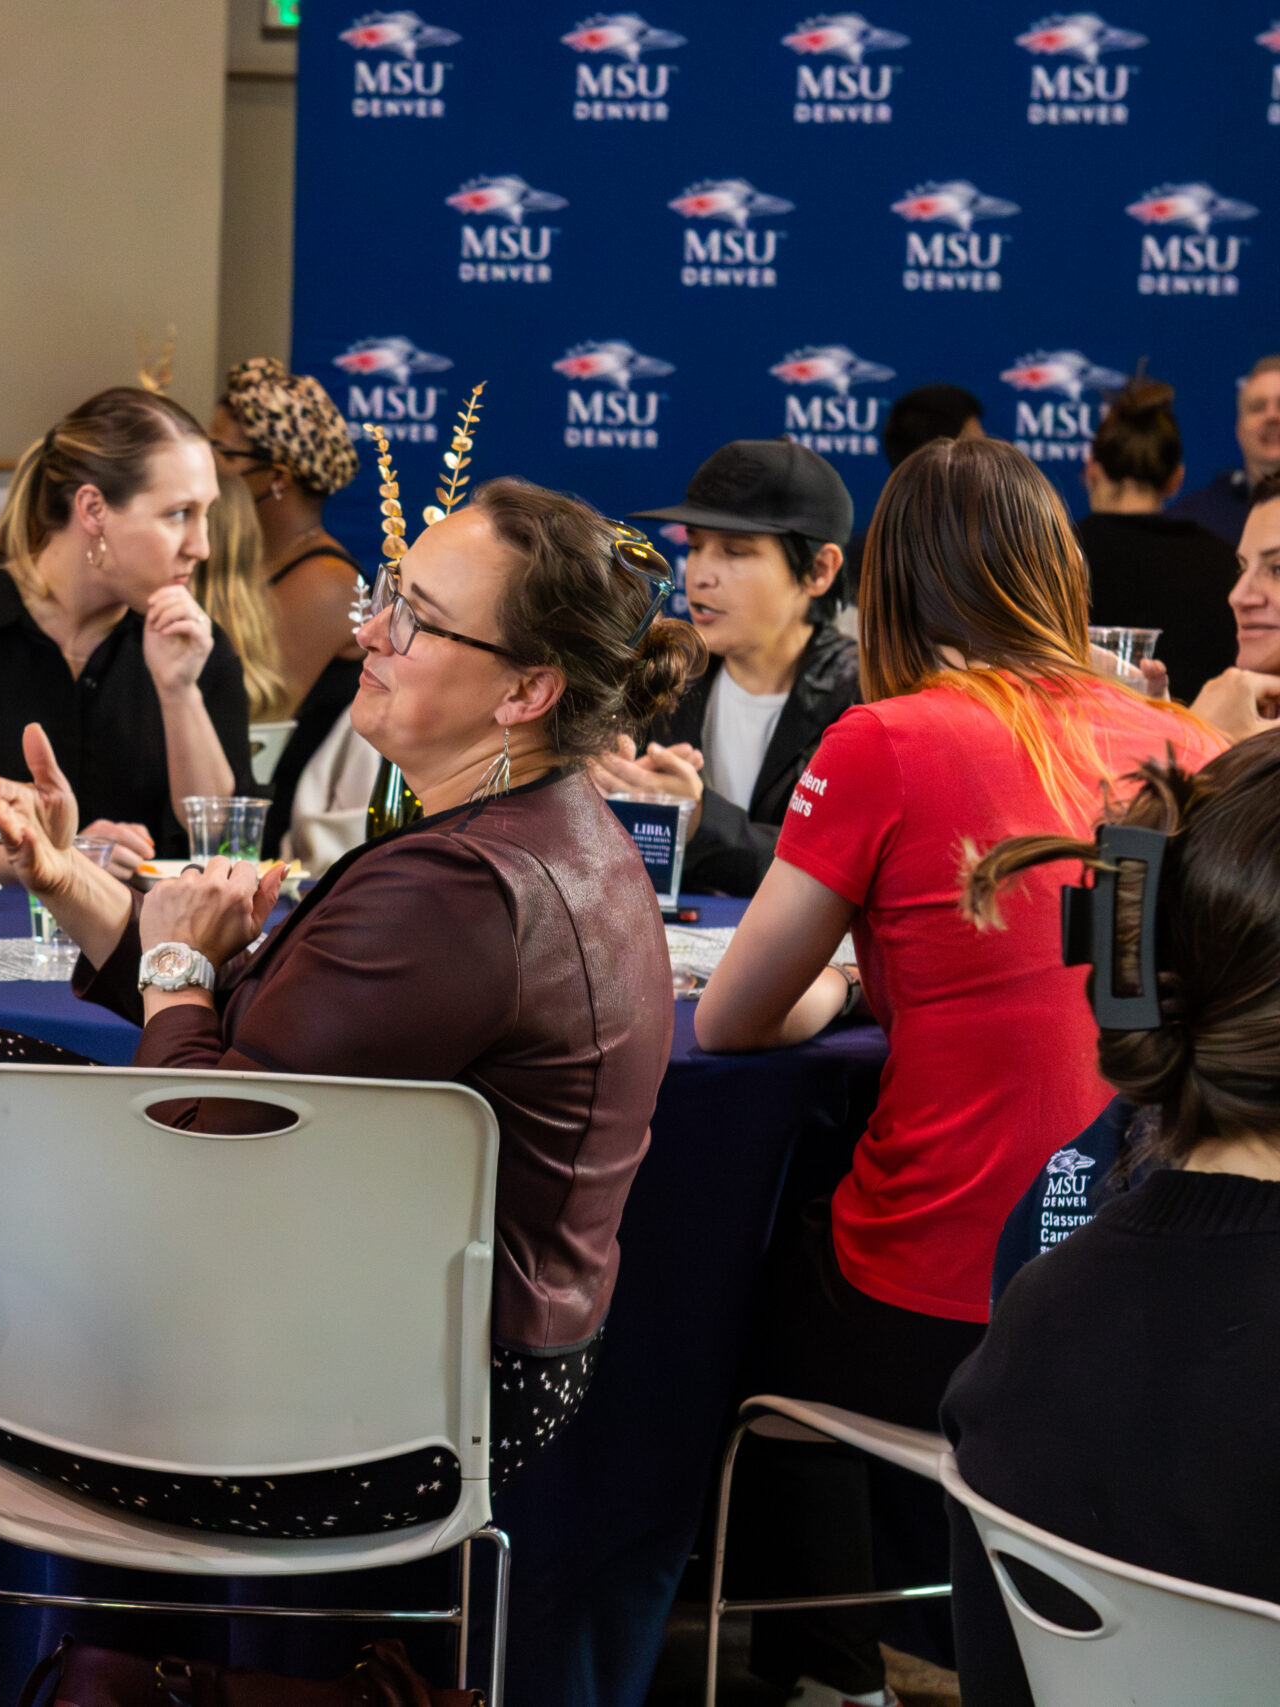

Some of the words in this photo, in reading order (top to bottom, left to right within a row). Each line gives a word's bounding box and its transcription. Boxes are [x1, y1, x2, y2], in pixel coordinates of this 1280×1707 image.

[355, 61, 444, 95] MSU
[577, 64, 668, 98] MSU
[797, 65, 892, 100] MSU
[1031, 66, 1128, 100] MSU
[352, 98, 444, 118] DENVER
[573, 101, 668, 121] DENVER
[794, 103, 891, 123] DENVER
[1027, 104, 1128, 124] DENVER
[462, 226, 551, 260] MSU
[685, 229, 776, 263] MSU
[907, 233, 1002, 268] MSU
[1142, 236, 1239, 271] MSU
[459, 263, 551, 283] DENVER
[681, 267, 776, 287] DENVER
[903, 271, 1001, 291] DENVER
[1138, 275, 1238, 295] DENVER
[348, 385, 437, 420] MSU
[568, 391, 658, 425] MSU
[785, 395, 878, 432] MSU
[565, 428, 658, 448] DENVER
[1014, 440, 1094, 461] DENVE
[800, 768, 827, 796] dent
[633, 823, 671, 837] LIBRA
[1046, 1175, 1087, 1196] MSU
[1043, 1196, 1087, 1208] DENVER
